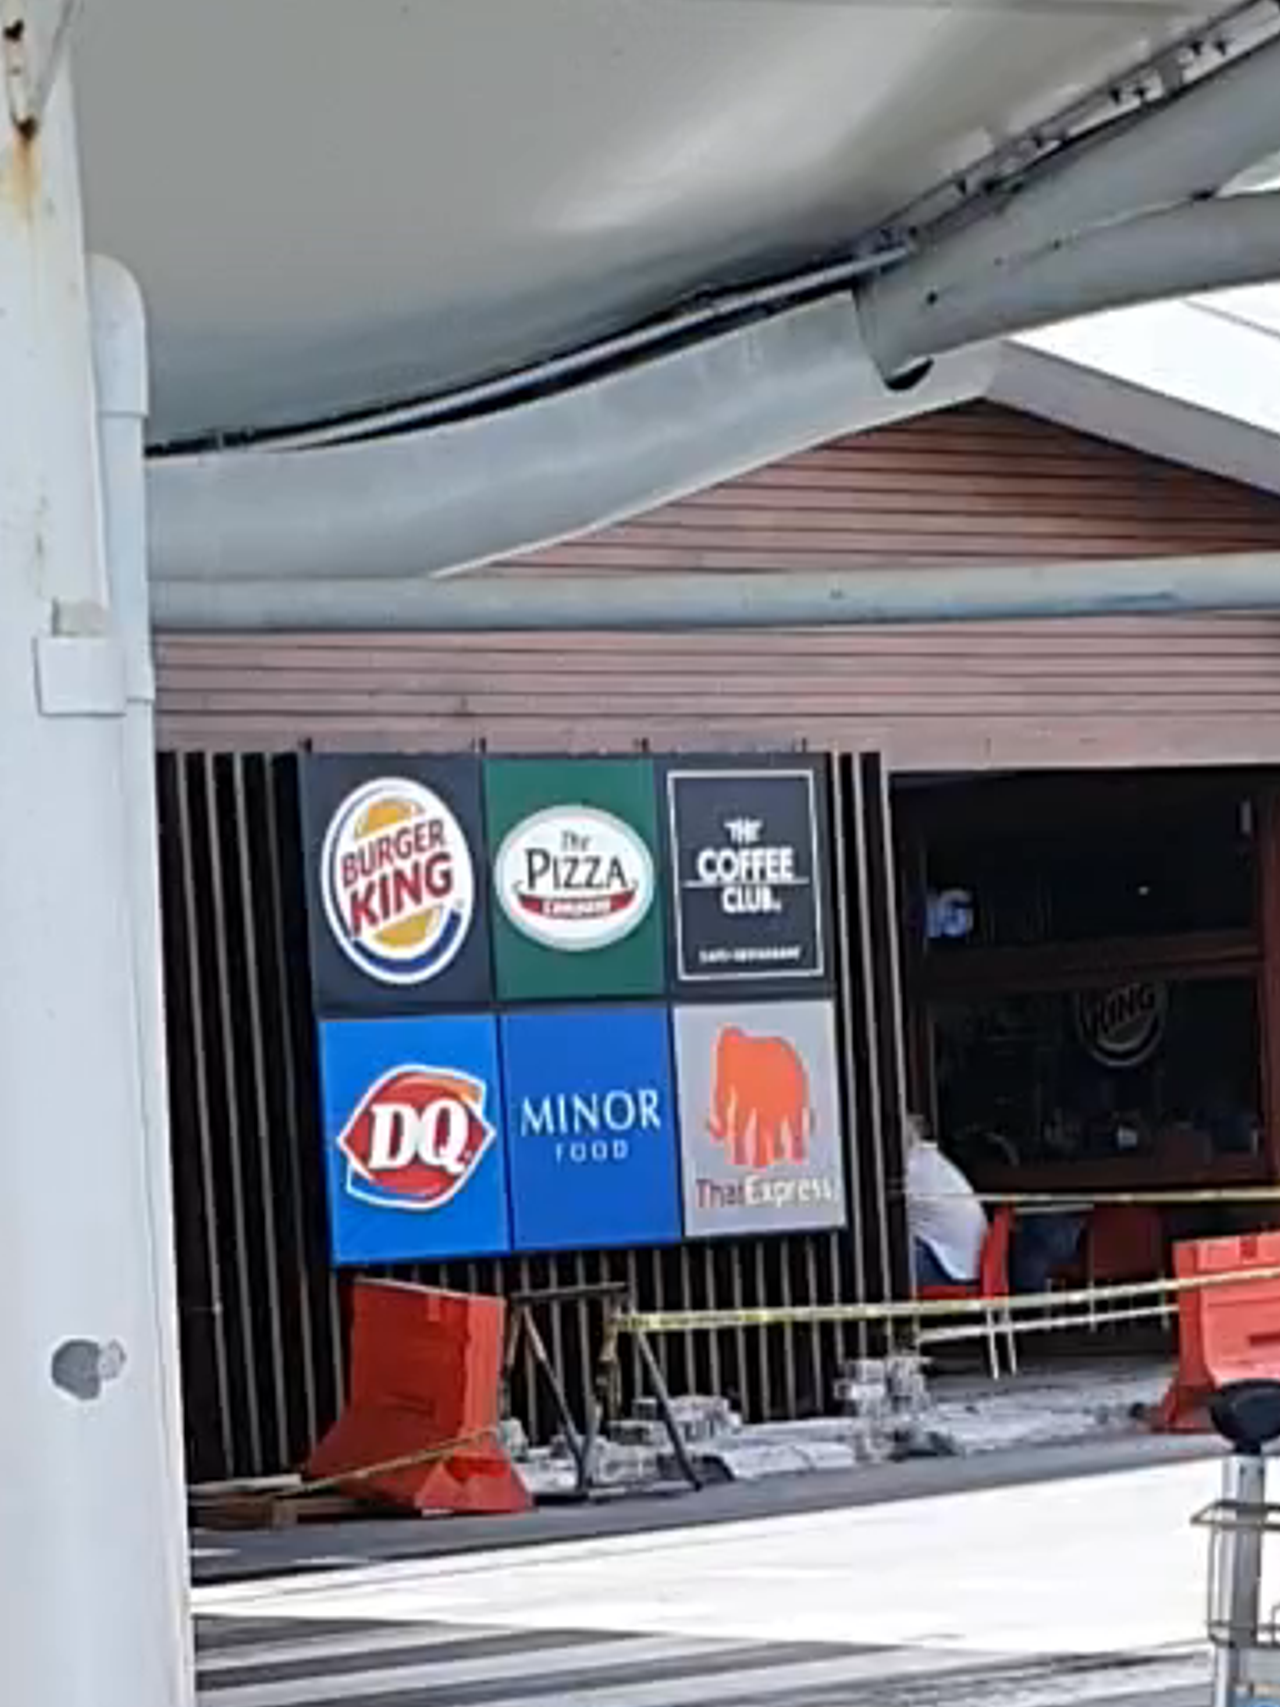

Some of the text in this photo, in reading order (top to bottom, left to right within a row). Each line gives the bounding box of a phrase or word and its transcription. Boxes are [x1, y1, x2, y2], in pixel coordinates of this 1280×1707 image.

[341, 819, 446, 889] BURGER
[525, 847, 629, 890] PIZZA
[697, 847, 794, 883] COFFEE
[350, 851, 453, 938] KING
[368, 1099, 469, 1173] DQ
[521, 1088, 662, 1137] MINOR
[556, 1139, 629, 1163] FOOD
